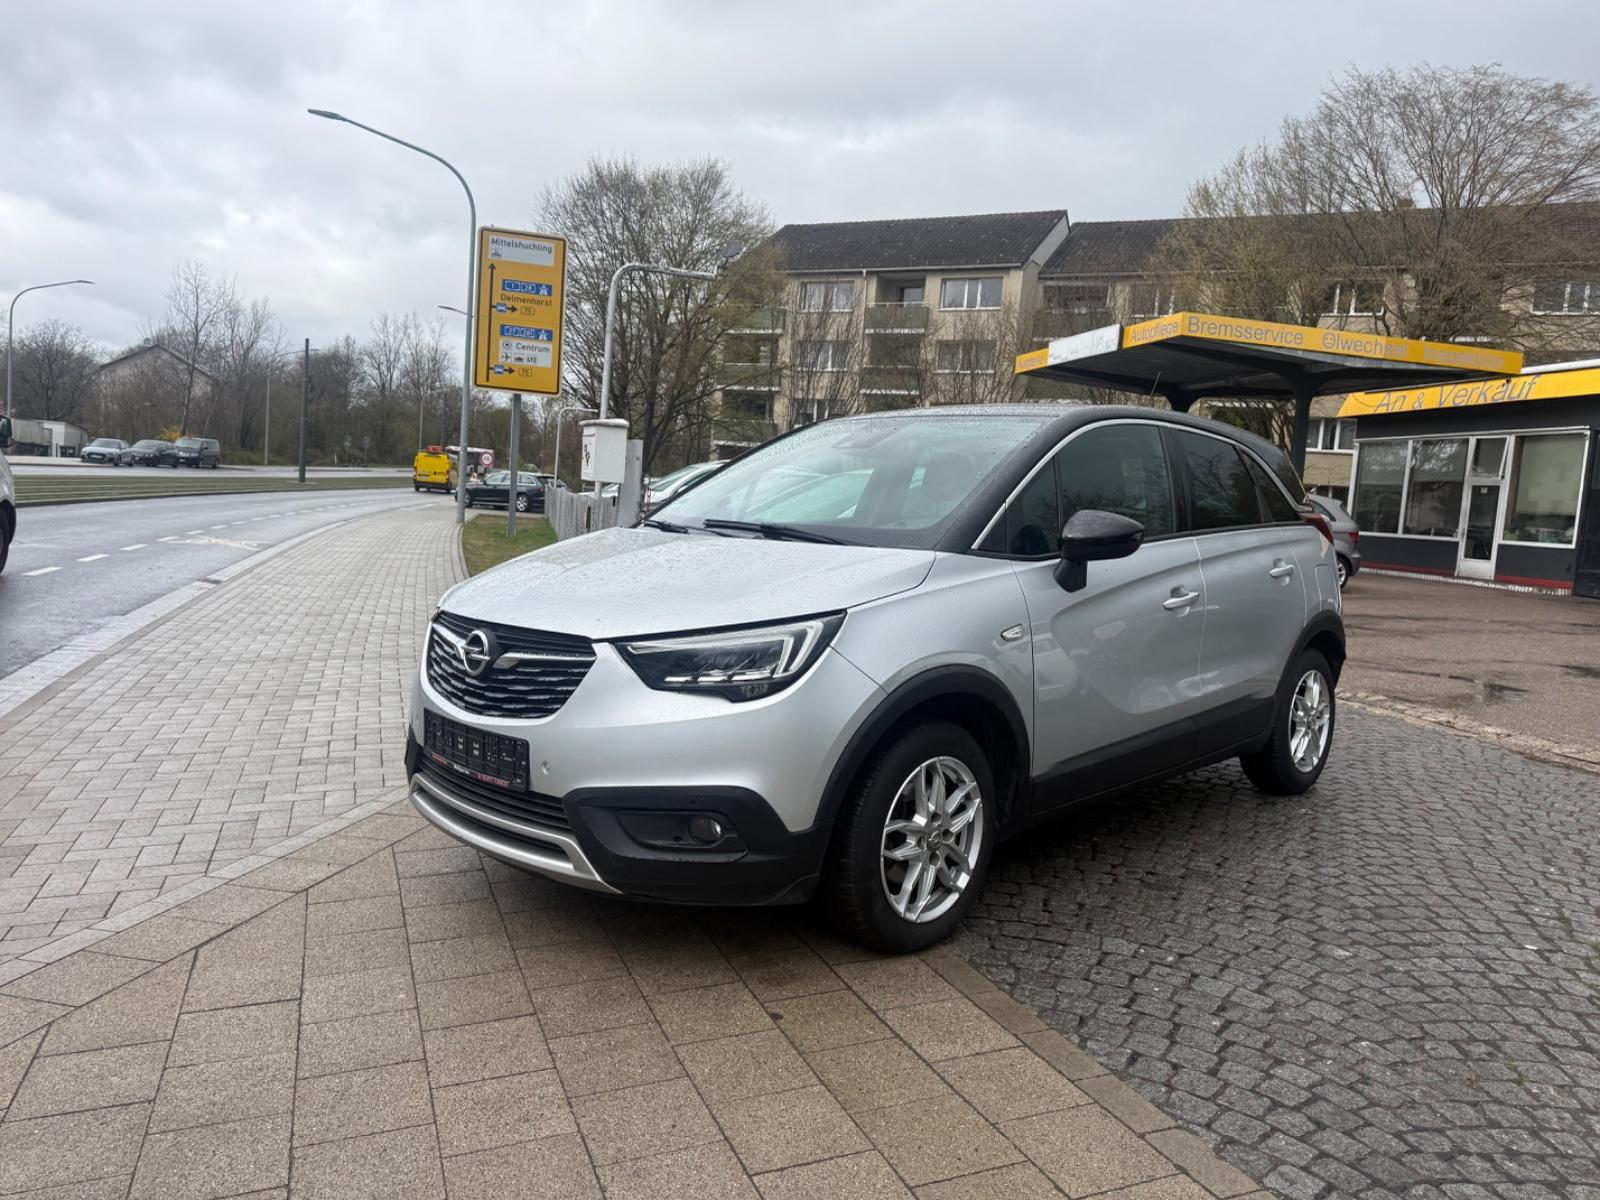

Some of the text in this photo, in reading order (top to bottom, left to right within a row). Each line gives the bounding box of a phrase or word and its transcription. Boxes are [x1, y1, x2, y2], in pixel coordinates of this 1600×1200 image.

[491, 238, 553, 254] Mittelshuchting
[501, 293, 552, 307] Delmenhorst
[1187, 316, 1304, 346] Bremsservice
[516, 342, 550, 353] Centrum
[1375, 374, 1540, 413] An & Verkauf
